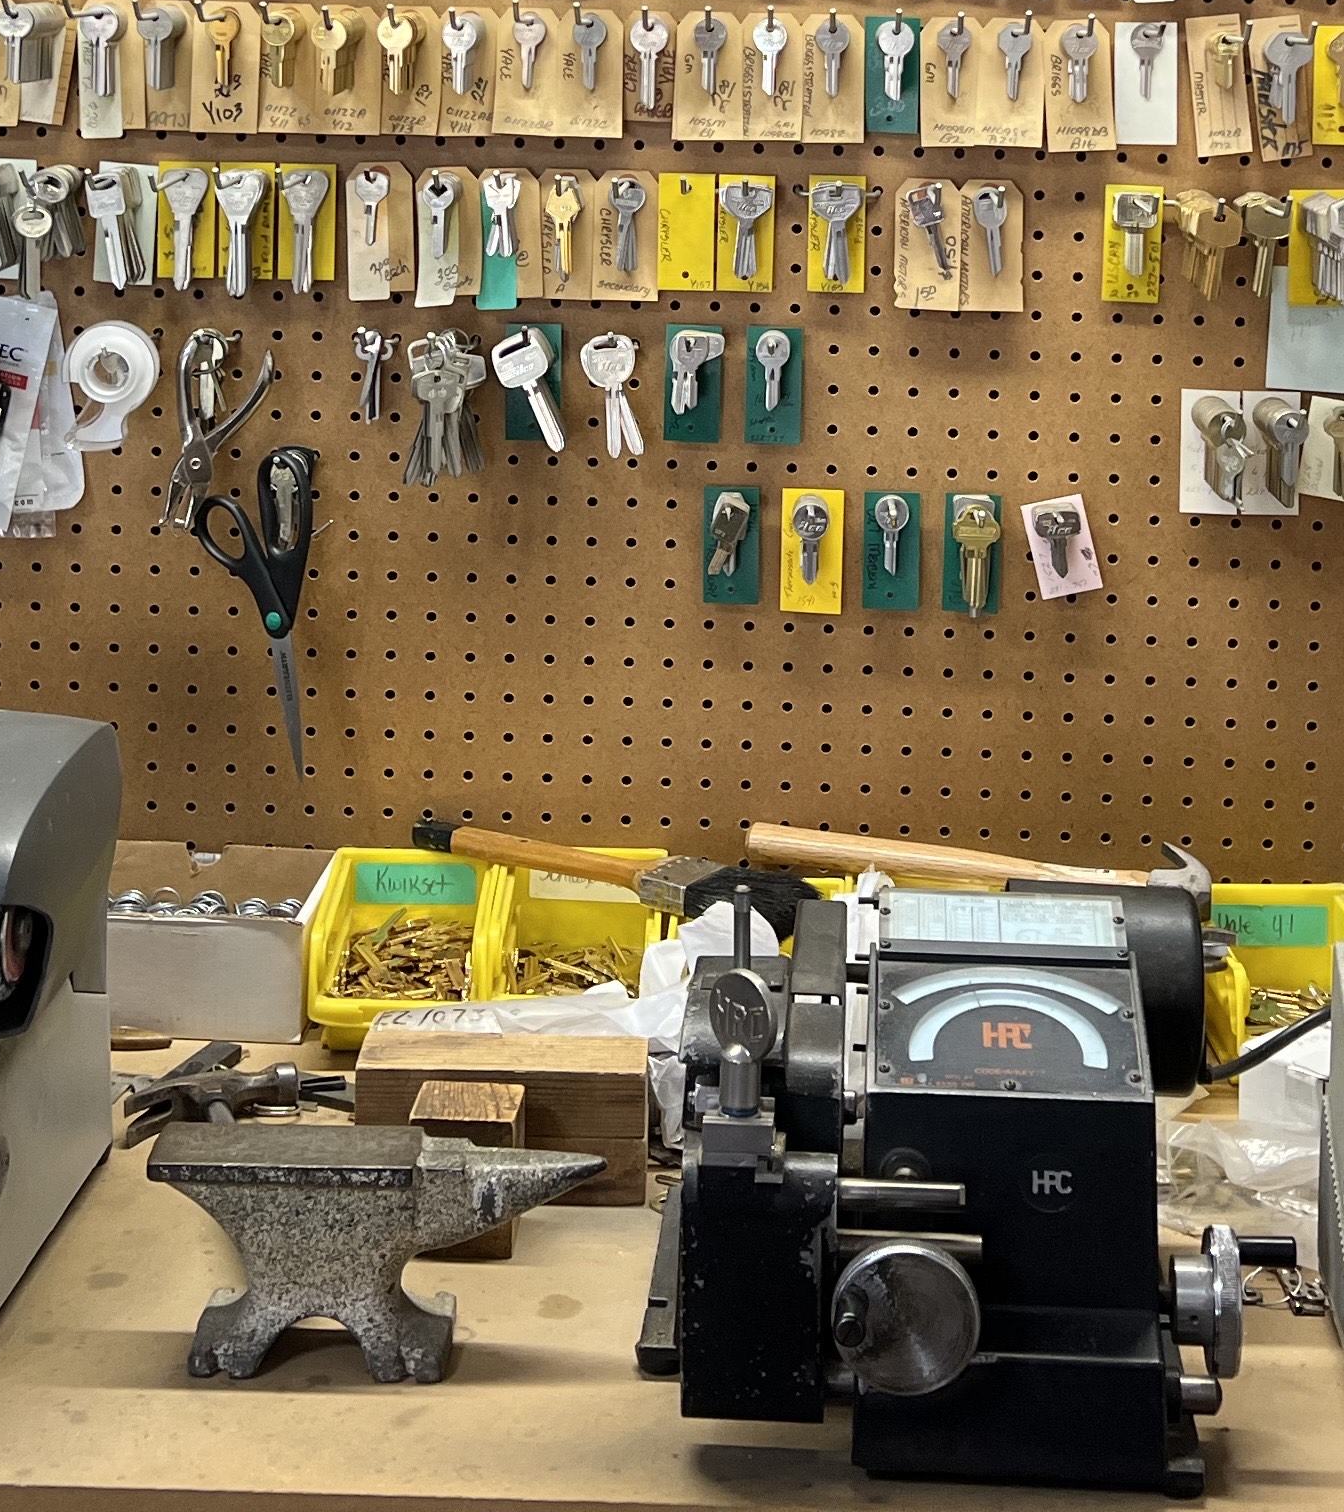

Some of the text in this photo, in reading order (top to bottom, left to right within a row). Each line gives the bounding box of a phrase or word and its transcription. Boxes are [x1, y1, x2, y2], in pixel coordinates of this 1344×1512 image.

[202, 100, 243, 124] Y103
[982, 1021, 1033, 1050] HPC
[1031, 1169, 1072, 1197] HPC
